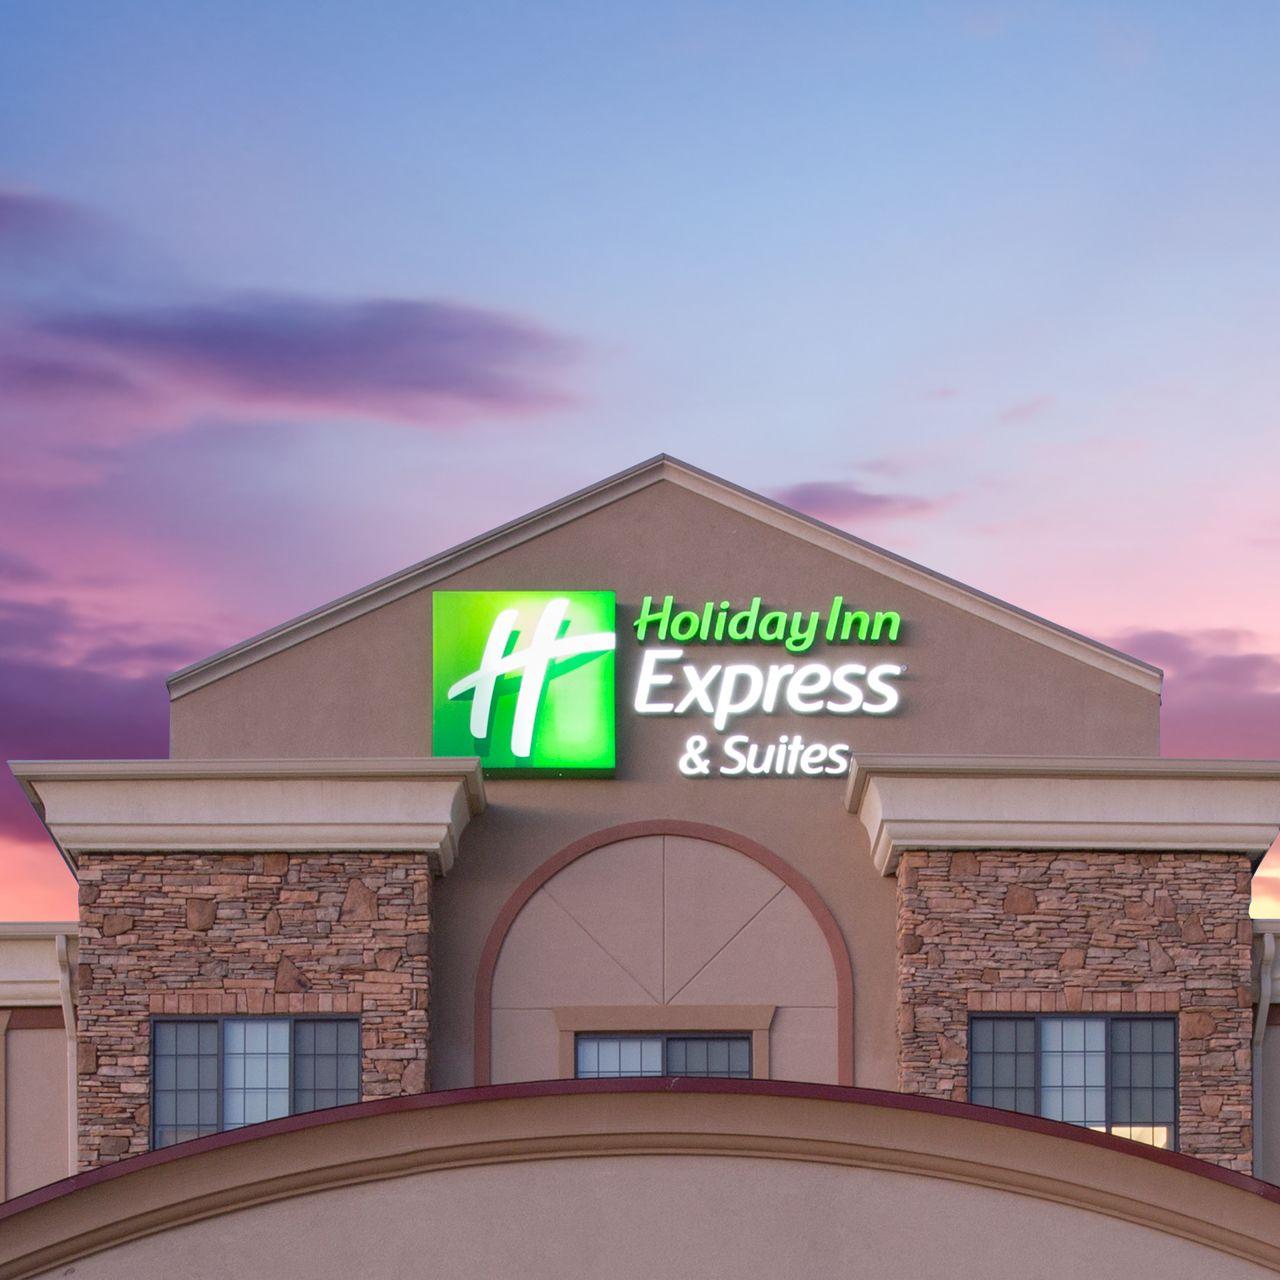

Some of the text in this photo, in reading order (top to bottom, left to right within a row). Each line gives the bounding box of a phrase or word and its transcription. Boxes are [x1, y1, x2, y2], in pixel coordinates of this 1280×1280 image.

[633, 595, 902, 653] Holiday Inn
[633, 648, 903, 731] Express
[678, 734, 850, 777] & Suites
